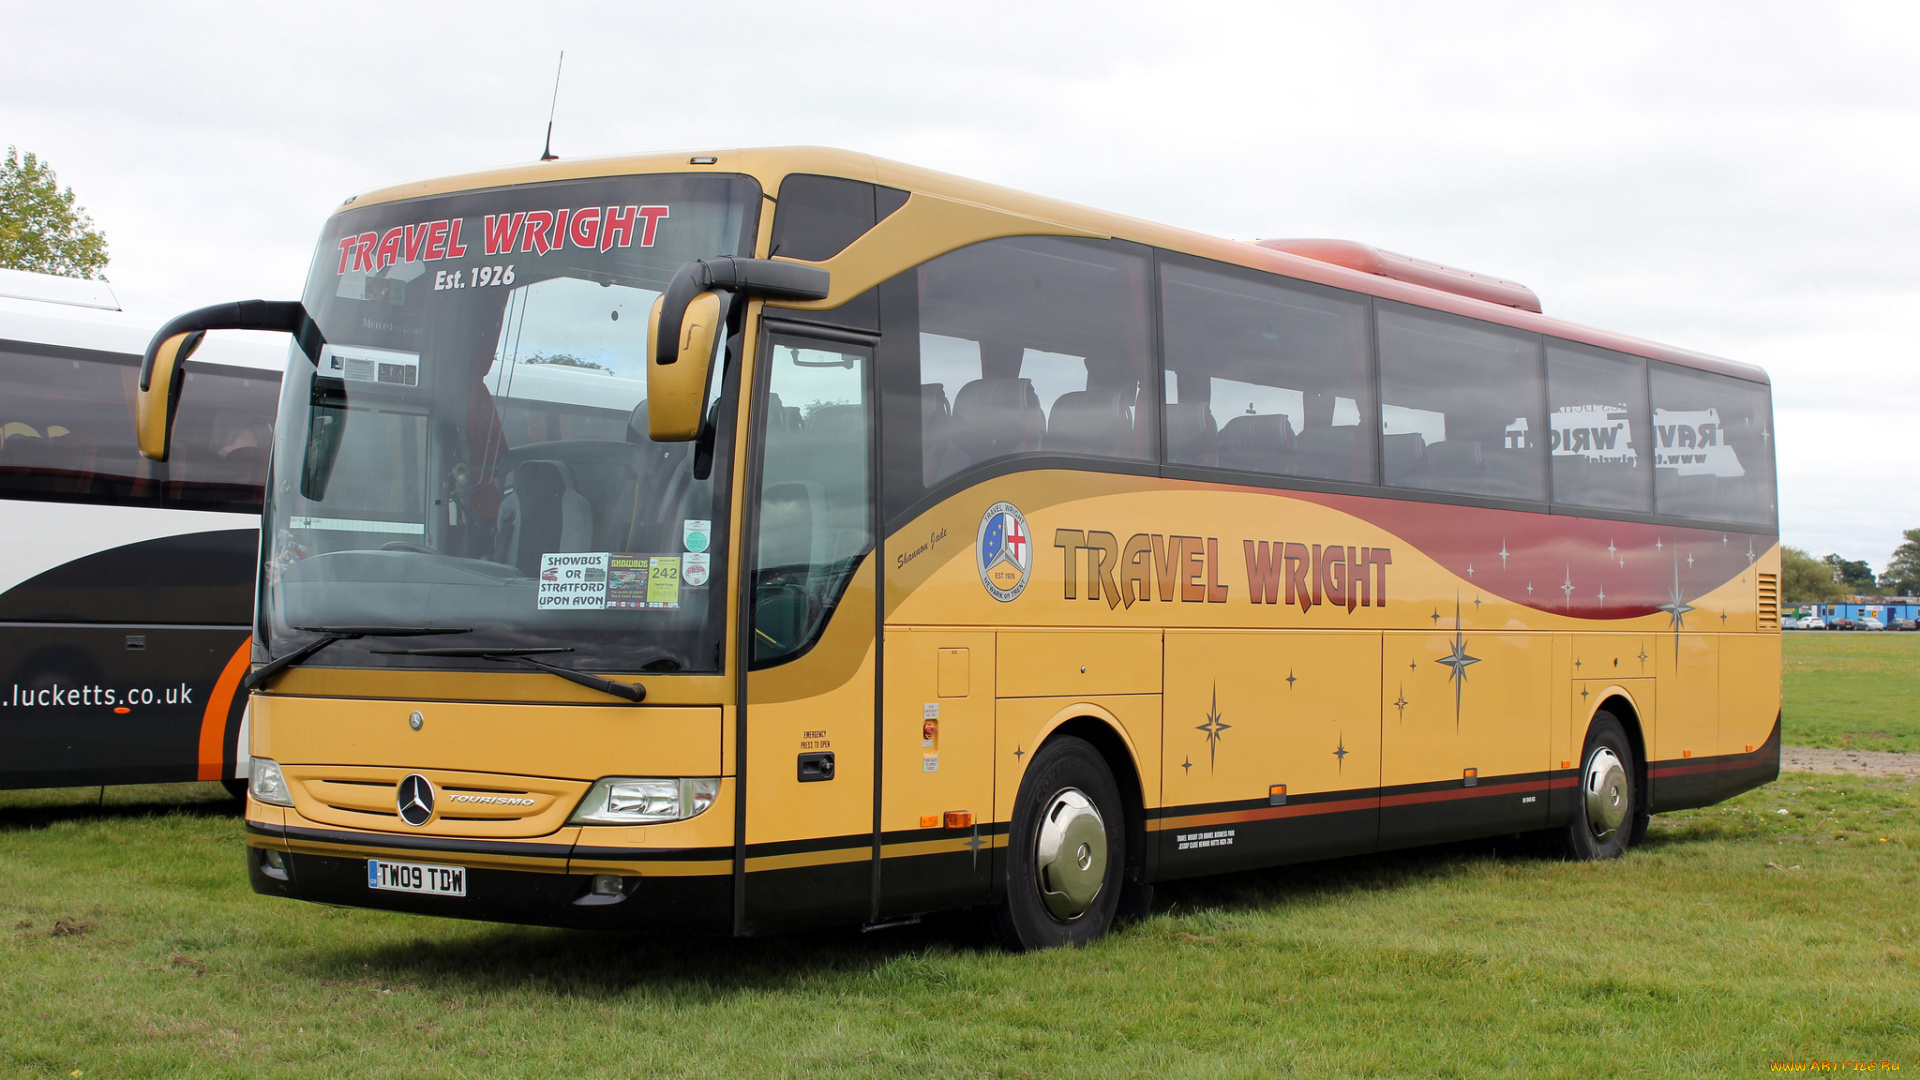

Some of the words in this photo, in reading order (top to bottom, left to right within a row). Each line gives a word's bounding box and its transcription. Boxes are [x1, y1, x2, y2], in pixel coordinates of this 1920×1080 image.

[337, 218, 468, 275] TRAVEL
[484, 205, 669, 257] WRIGHT
[434, 271, 465, 291] Est.
[471, 265, 516, 287] 1926
[984, 504, 1003, 523] TRAVEL
[1005, 504, 1025, 525] WRIGHT
[897, 543, 928, 569] Shannon
[931, 527, 947, 550] Jade
[547, 556, 602, 566] SHOWBUS
[611, 560, 649, 568] SHOWBUS
[565, 570, 582, 579] OR
[652, 567, 678, 579] 242
[1054, 528, 1229, 610] TRAVEL
[1243, 539, 1393, 614] WRIGHT
[541, 583, 605, 593] STRATFORD
[984, 577, 1003, 599] NEWARK
[1011, 579, 1026, 598] TRENT
[539, 596, 570, 606] UPON
[572, 596, 604, 606] AVON
[3, 683, 193, 706] .lucketts.co.uk
[804, 730, 826, 739] EMERGENCY
[801, 741, 813, 749] PRESS
[814, 741, 819, 749] TO
[820, 740, 831, 749] OPEN
[449, 794, 534, 806] TOURISMO
[379, 863, 422, 889] TW09
[428, 868, 463, 892] TDW
